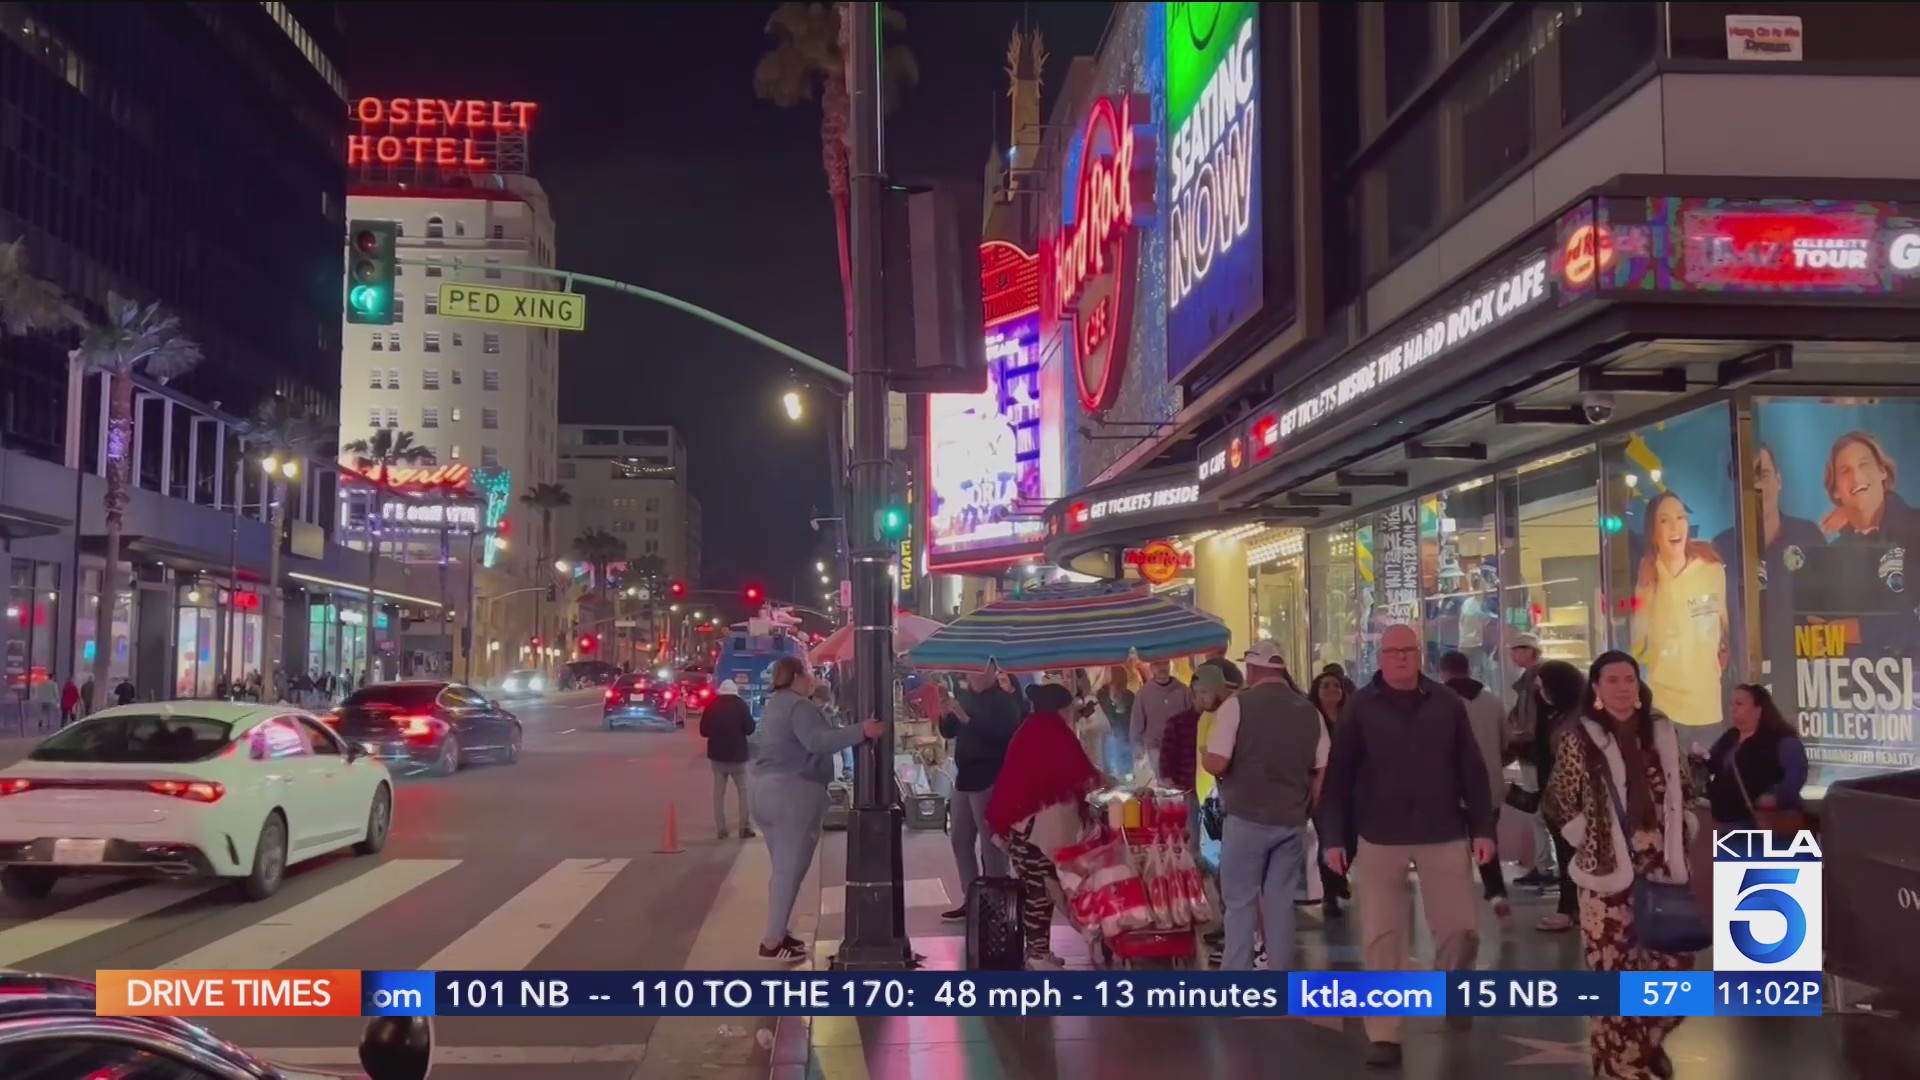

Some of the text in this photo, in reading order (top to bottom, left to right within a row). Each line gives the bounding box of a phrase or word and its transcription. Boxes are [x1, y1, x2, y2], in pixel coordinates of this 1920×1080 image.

[348, 97, 538, 131] OSEVELT
[1172, 17, 1254, 202] SEATING
[348, 134, 487, 165] HOTEL
[1170, 99, 1254, 309] NOW
[1793, 249, 1868, 269] TOUR
[448, 289, 573, 321] PED XING
[1298, 385, 1337, 429] TICKETS
[1338, 360, 1377, 406] INSIDE
[1378, 347, 1402, 383] THE
[1403, 321, 1446, 372] HARD
[1446, 289, 1495, 346] ROCK
[1497, 259, 1546, 317] CAFE
[1090, 501, 1107, 519] GET
[1108, 493, 1152, 515] TICKETS
[1153, 485, 1199, 507] INSIDE
[1795, 624, 1846, 657] NEW
[1796, 657, 1913, 711] MESSI
[1798, 711, 1914, 742] COLLECTION
